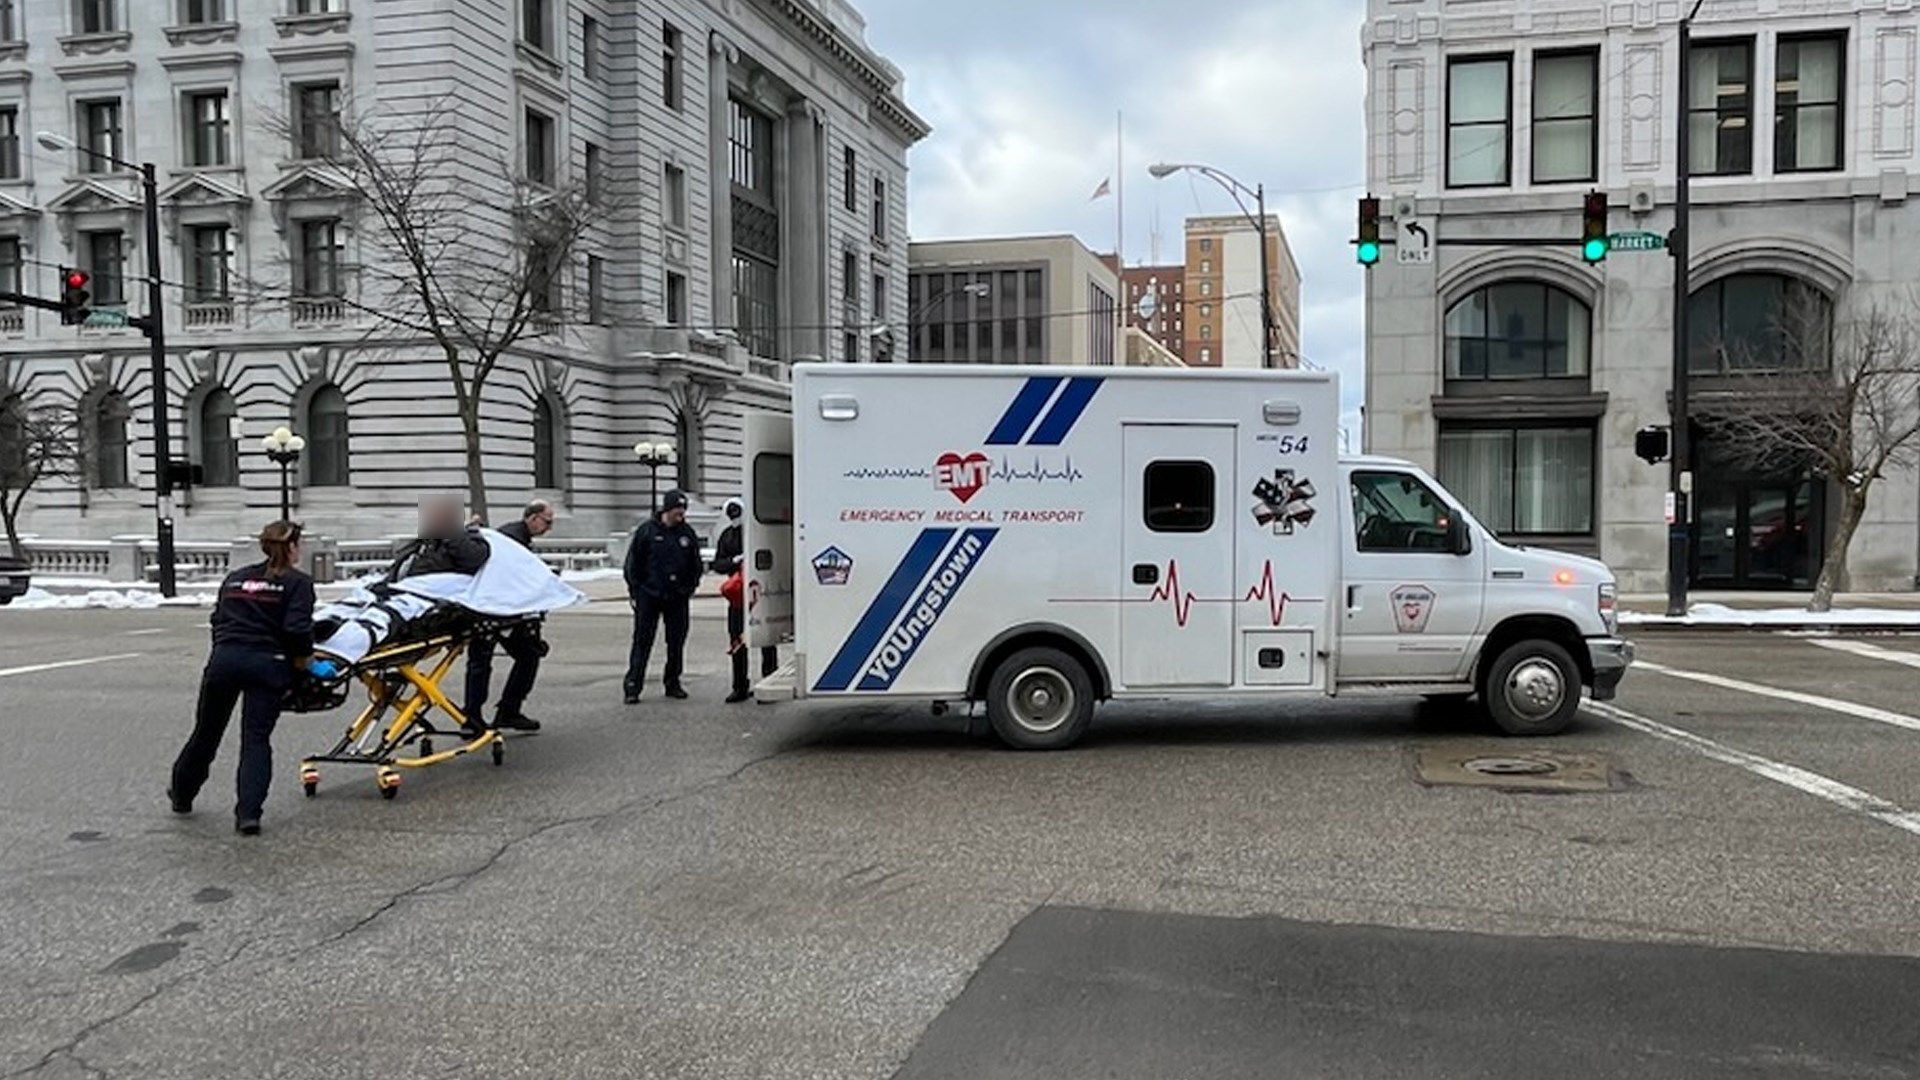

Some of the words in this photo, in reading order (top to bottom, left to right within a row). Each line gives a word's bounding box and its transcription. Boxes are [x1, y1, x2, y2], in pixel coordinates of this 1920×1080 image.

[1611, 236, 1653, 249] MARKET
[1401, 249, 1430, 261] ONLY
[1279, 435, 1308, 454] 54
[932, 459, 993, 490] EMT
[840, 510, 926, 523] EMERGENCY
[934, 510, 994, 523] MEDICAL
[1002, 510, 1085, 523] TRANSPORT
[868, 534, 983, 682] YOUngstown
